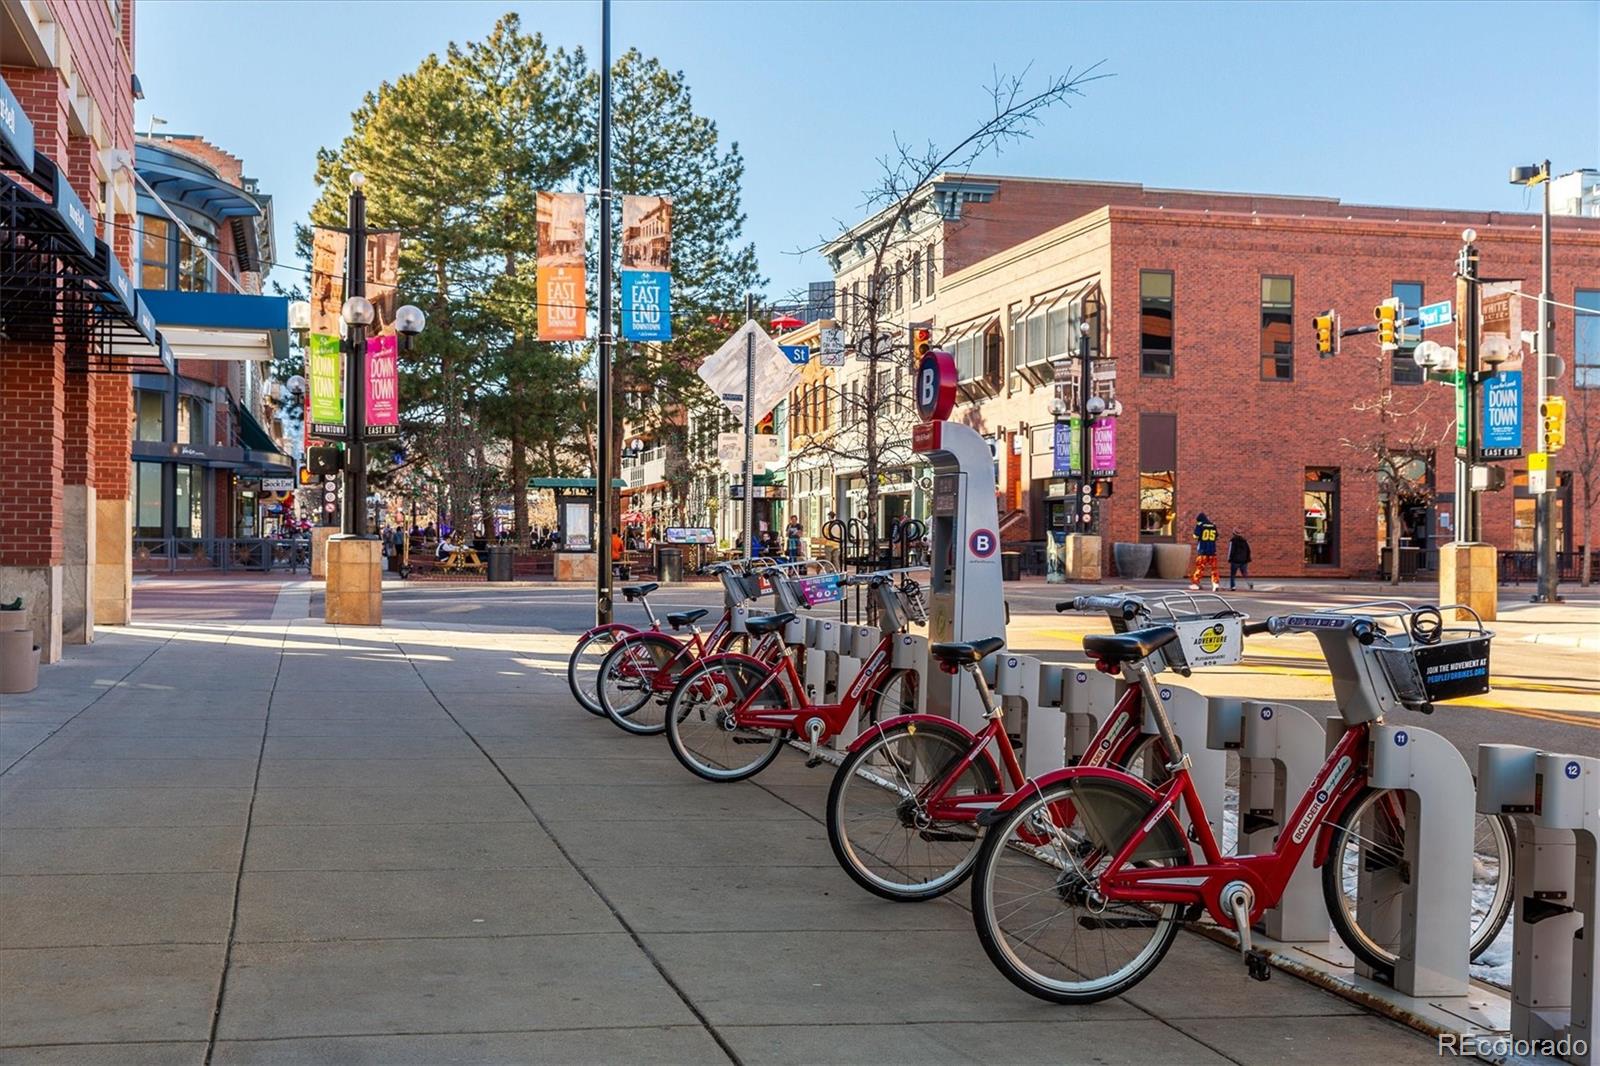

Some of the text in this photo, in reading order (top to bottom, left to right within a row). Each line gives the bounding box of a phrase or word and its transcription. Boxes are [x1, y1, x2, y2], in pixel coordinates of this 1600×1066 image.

[547, 282, 576, 300] EAST
[632, 286, 660, 304] EAST
[548, 301, 577, 320] END
[632, 304, 660, 323] END
[632, 323, 660, 331] DOWNTOWN
[793, 349, 805, 360] St
[313, 356, 335, 377] DOWN
[371, 358, 394, 378] DOWN
[313, 376, 336, 398] TOWN
[370, 378, 394, 399] TOWN
[922, 368, 934, 406] B
[1489, 389, 1518, 407] DOWN
[1489, 408, 1518, 426] TOWN
[315, 425, 344, 433] DOWNTOWN
[368, 425, 396, 434] EAST END
[1484, 448, 1518, 456] EAST END
[976, 535, 989, 550] B
[1201, 529, 1217, 541] 05
[1193, 635, 1227, 645] ADVENTURE
[1427, 658, 1487, 675] JOIN THE MOVEMENT AT
[1262, 710, 1271, 718] 10
[1397, 735, 1405, 743] 11
[1567, 766, 1578, 774] 12
[1295, 802, 1320, 840] BOULDER
[1318, 793, 1327, 801] B
